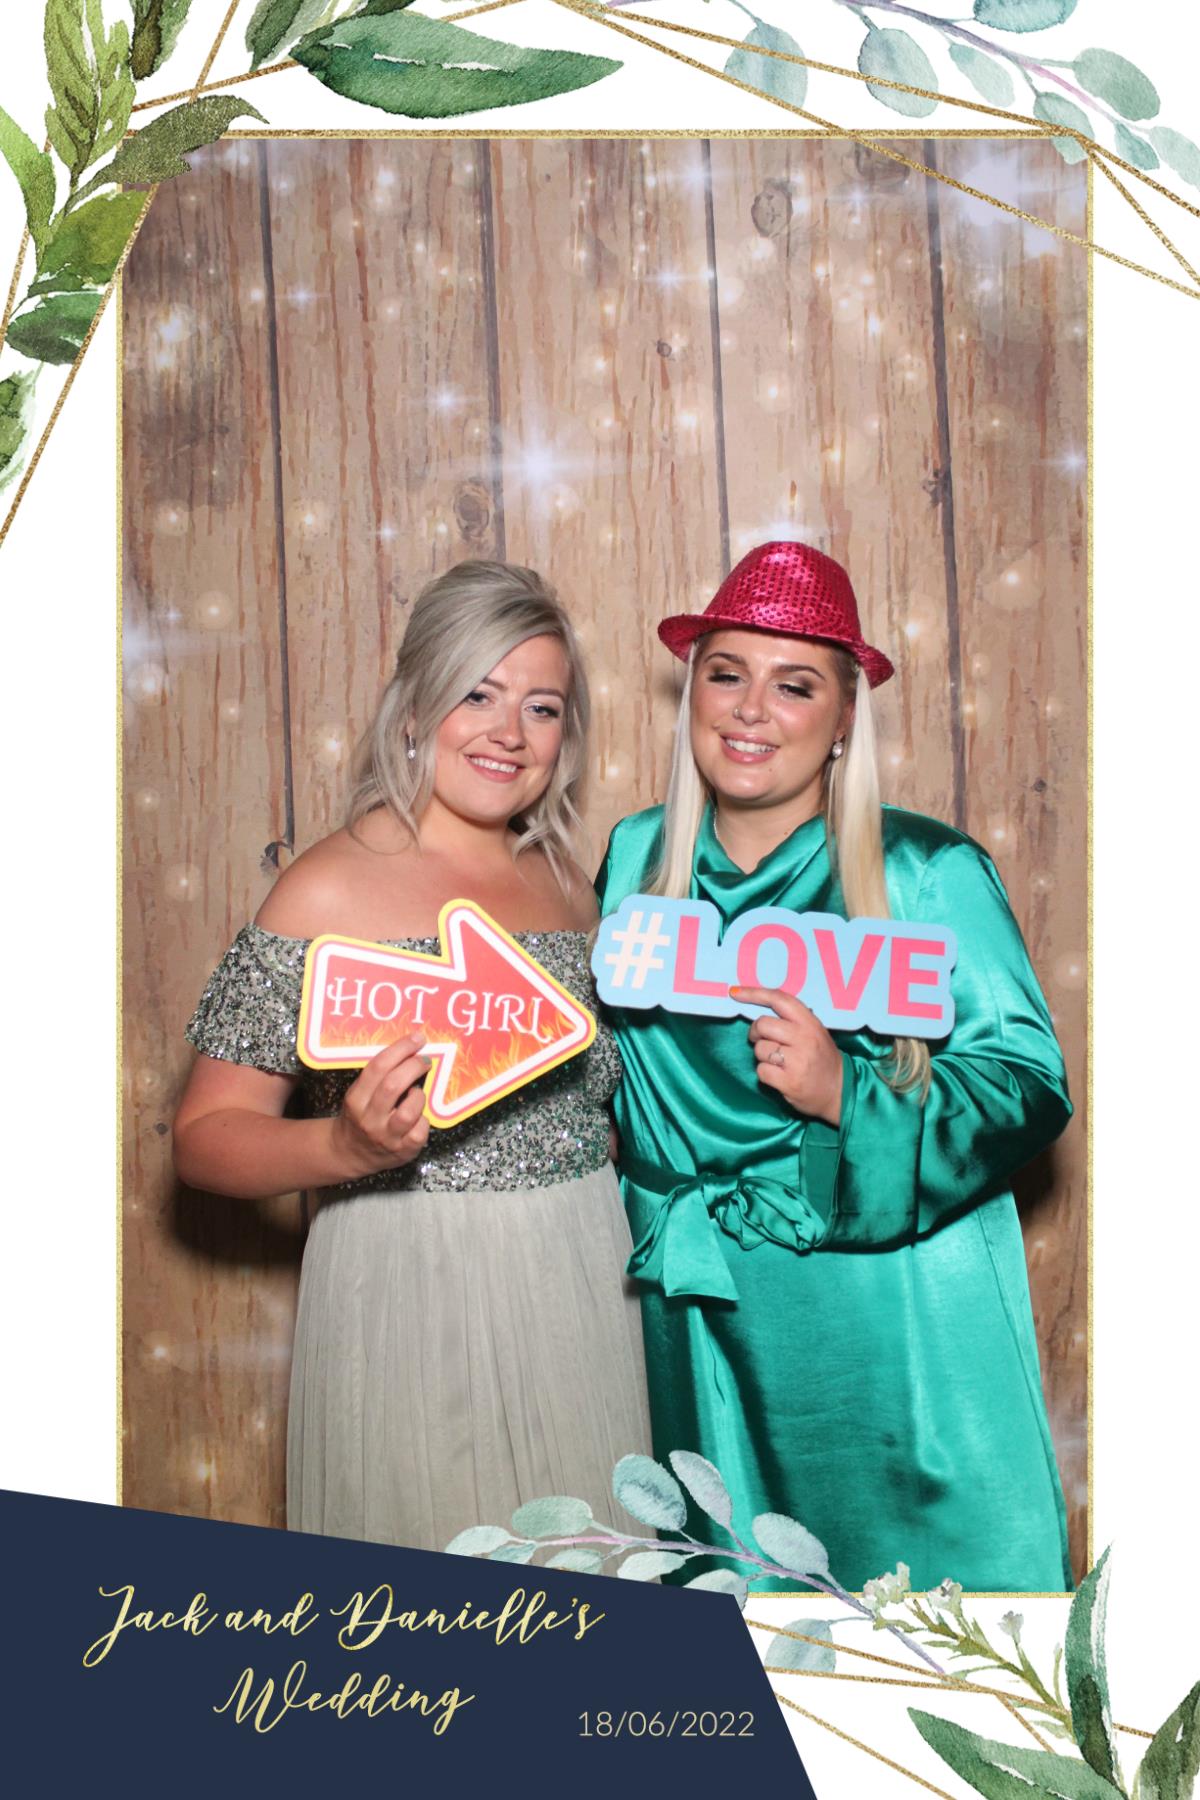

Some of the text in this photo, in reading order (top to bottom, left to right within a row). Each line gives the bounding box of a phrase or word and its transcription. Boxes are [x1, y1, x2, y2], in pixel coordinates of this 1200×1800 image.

[604, 911, 946, 1020] #LOVE
[326, 977, 554, 1043] HOT GIRL
